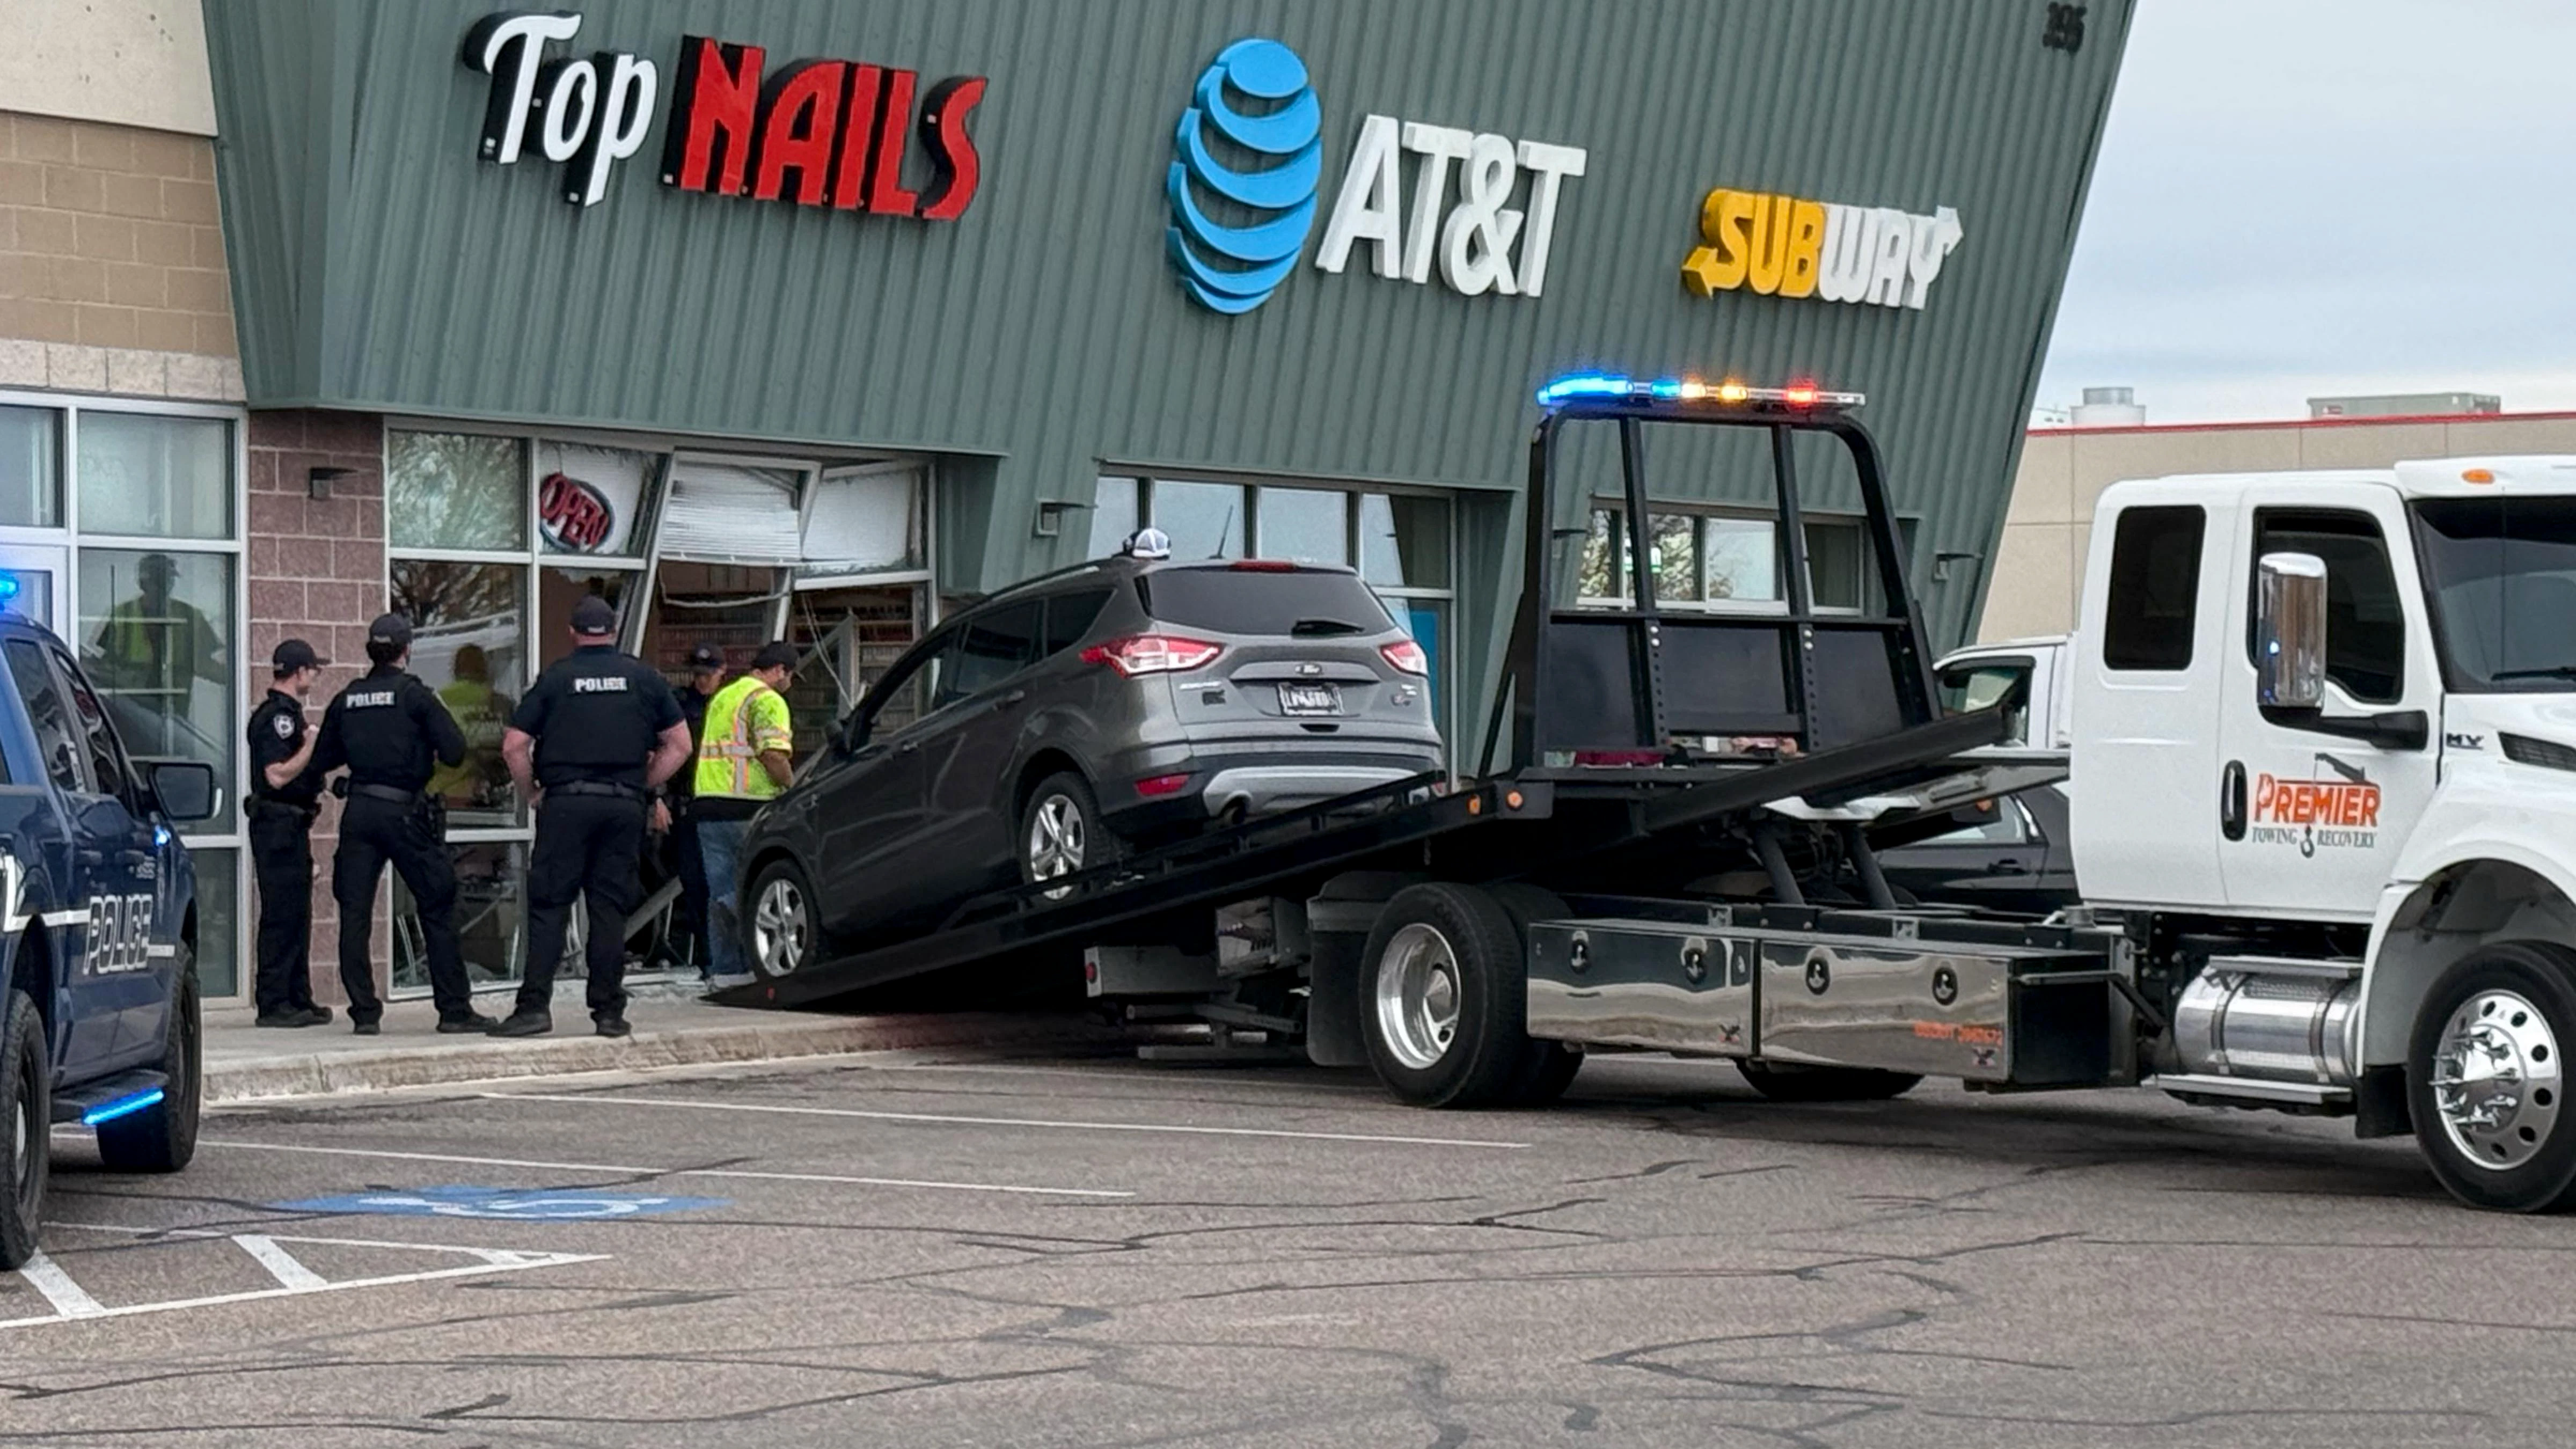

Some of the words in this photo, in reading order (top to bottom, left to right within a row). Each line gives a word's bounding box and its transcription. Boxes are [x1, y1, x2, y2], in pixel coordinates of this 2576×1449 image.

[479, 12, 658, 207] Top
[672, 35, 989, 222] NAILS
[1315, 113, 1587, 298] AT&T
[1681, 188, 1964, 311] SUBWAY
[540, 473, 610, 546] OPEN
[574, 677, 627, 692] POLICE
[2252, 827, 2299, 845] TOWING
[2317, 830, 2376, 848] RECOVERY
[2254, 773, 2381, 827] PREMIER
[83, 893, 153, 975] POLICE
